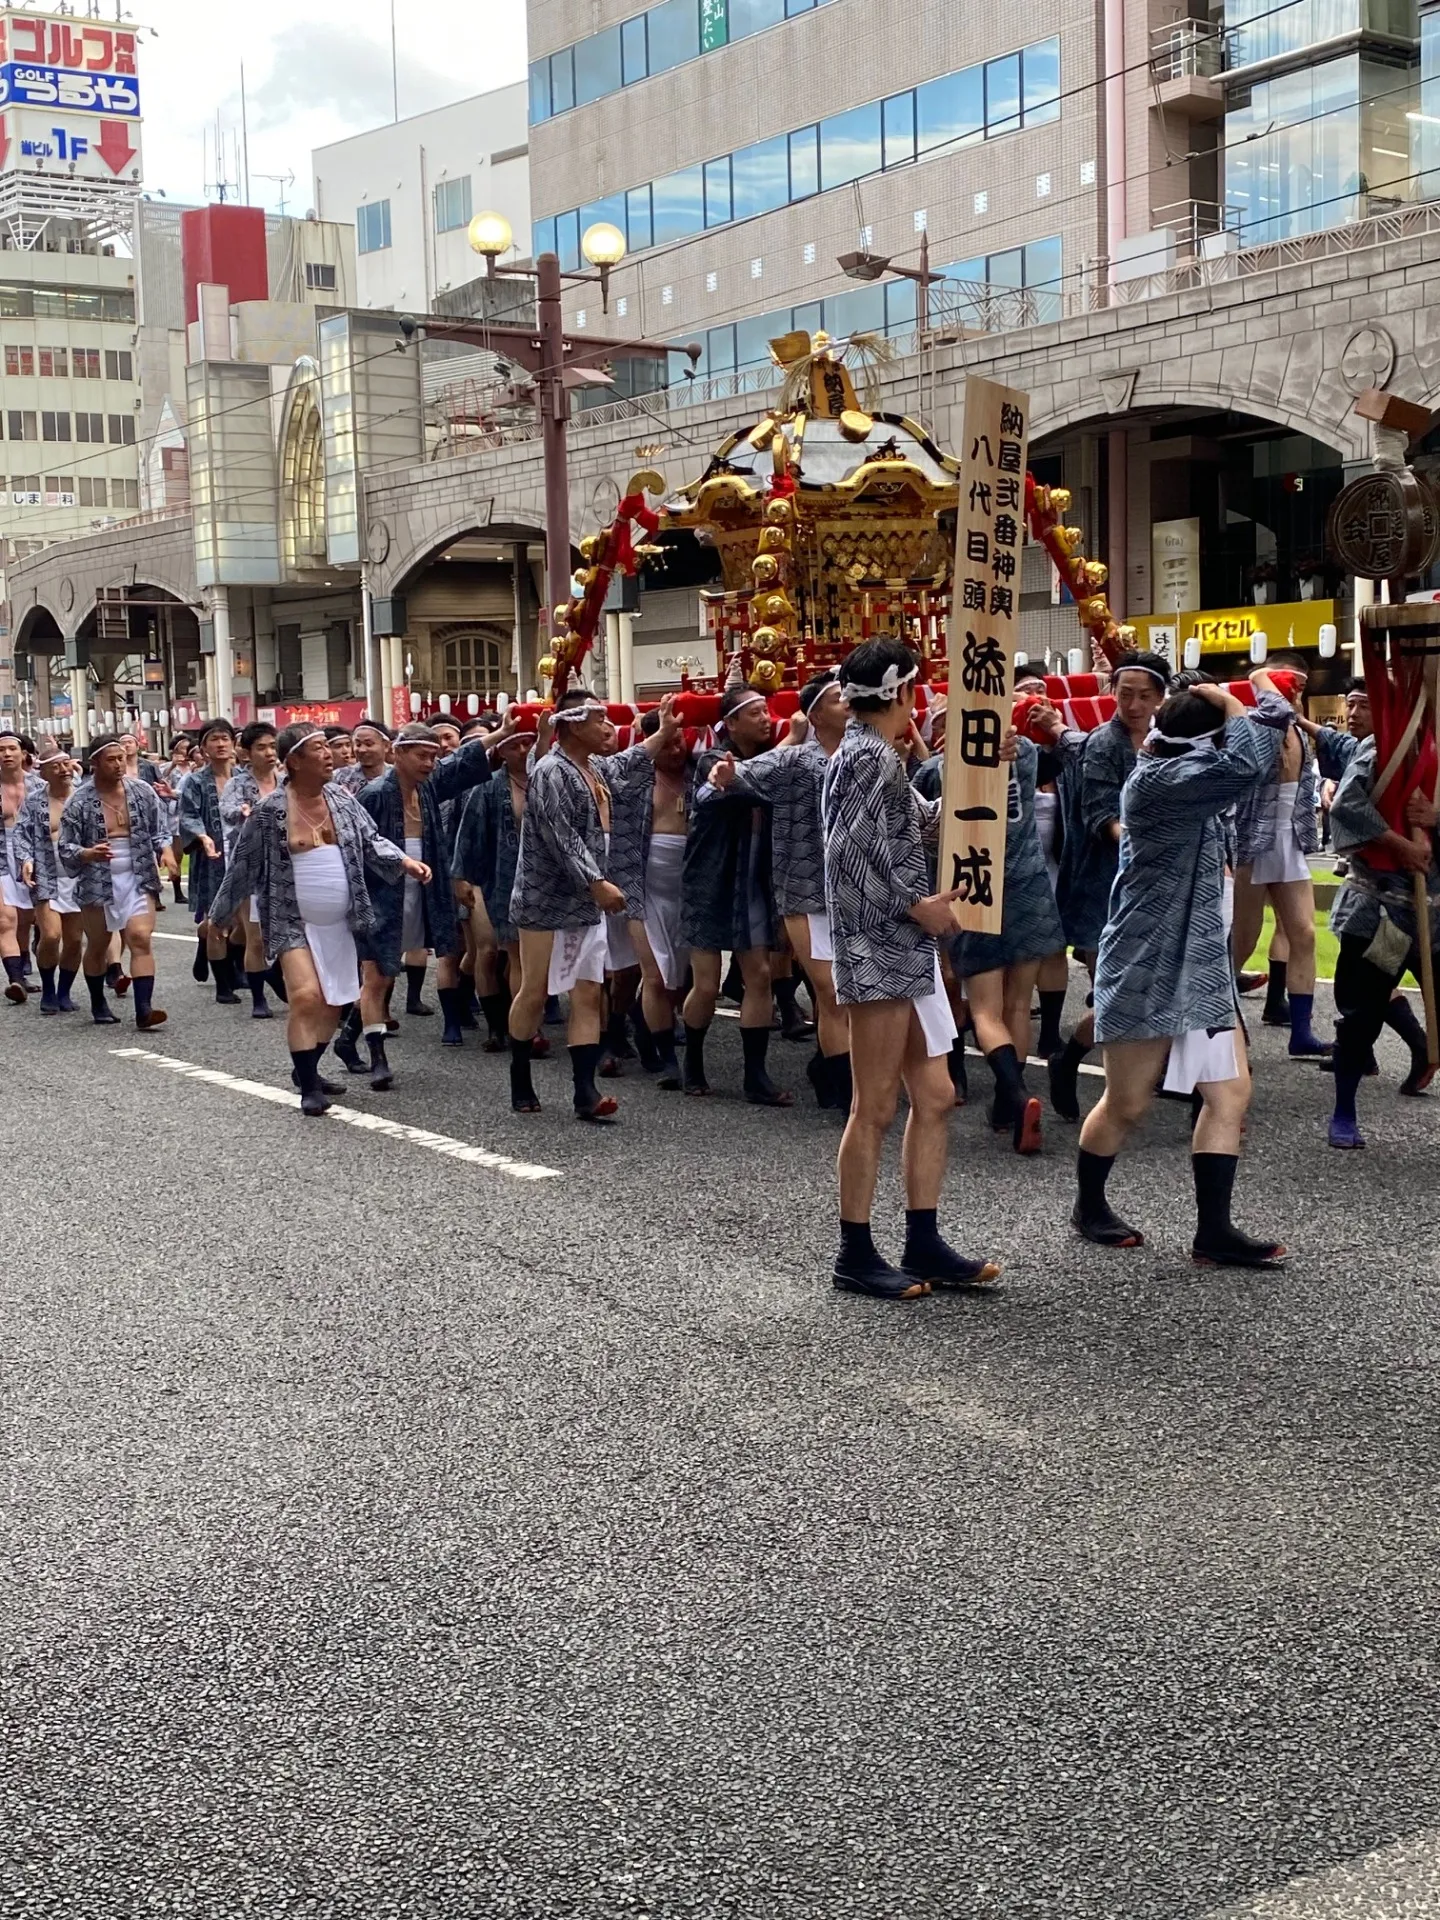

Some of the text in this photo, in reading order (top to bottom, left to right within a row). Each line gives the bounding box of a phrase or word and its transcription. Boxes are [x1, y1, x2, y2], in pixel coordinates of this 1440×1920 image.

[713, 0, 724, 20] 山
[14, 68, 54, 83] GOLF
[14, 73, 138, 111] つるや
[963, 434, 994, 614] 八代目頭
[1193, 619, 1255, 642] バイセル
[950, 631, 1006, 908] 添田一成
